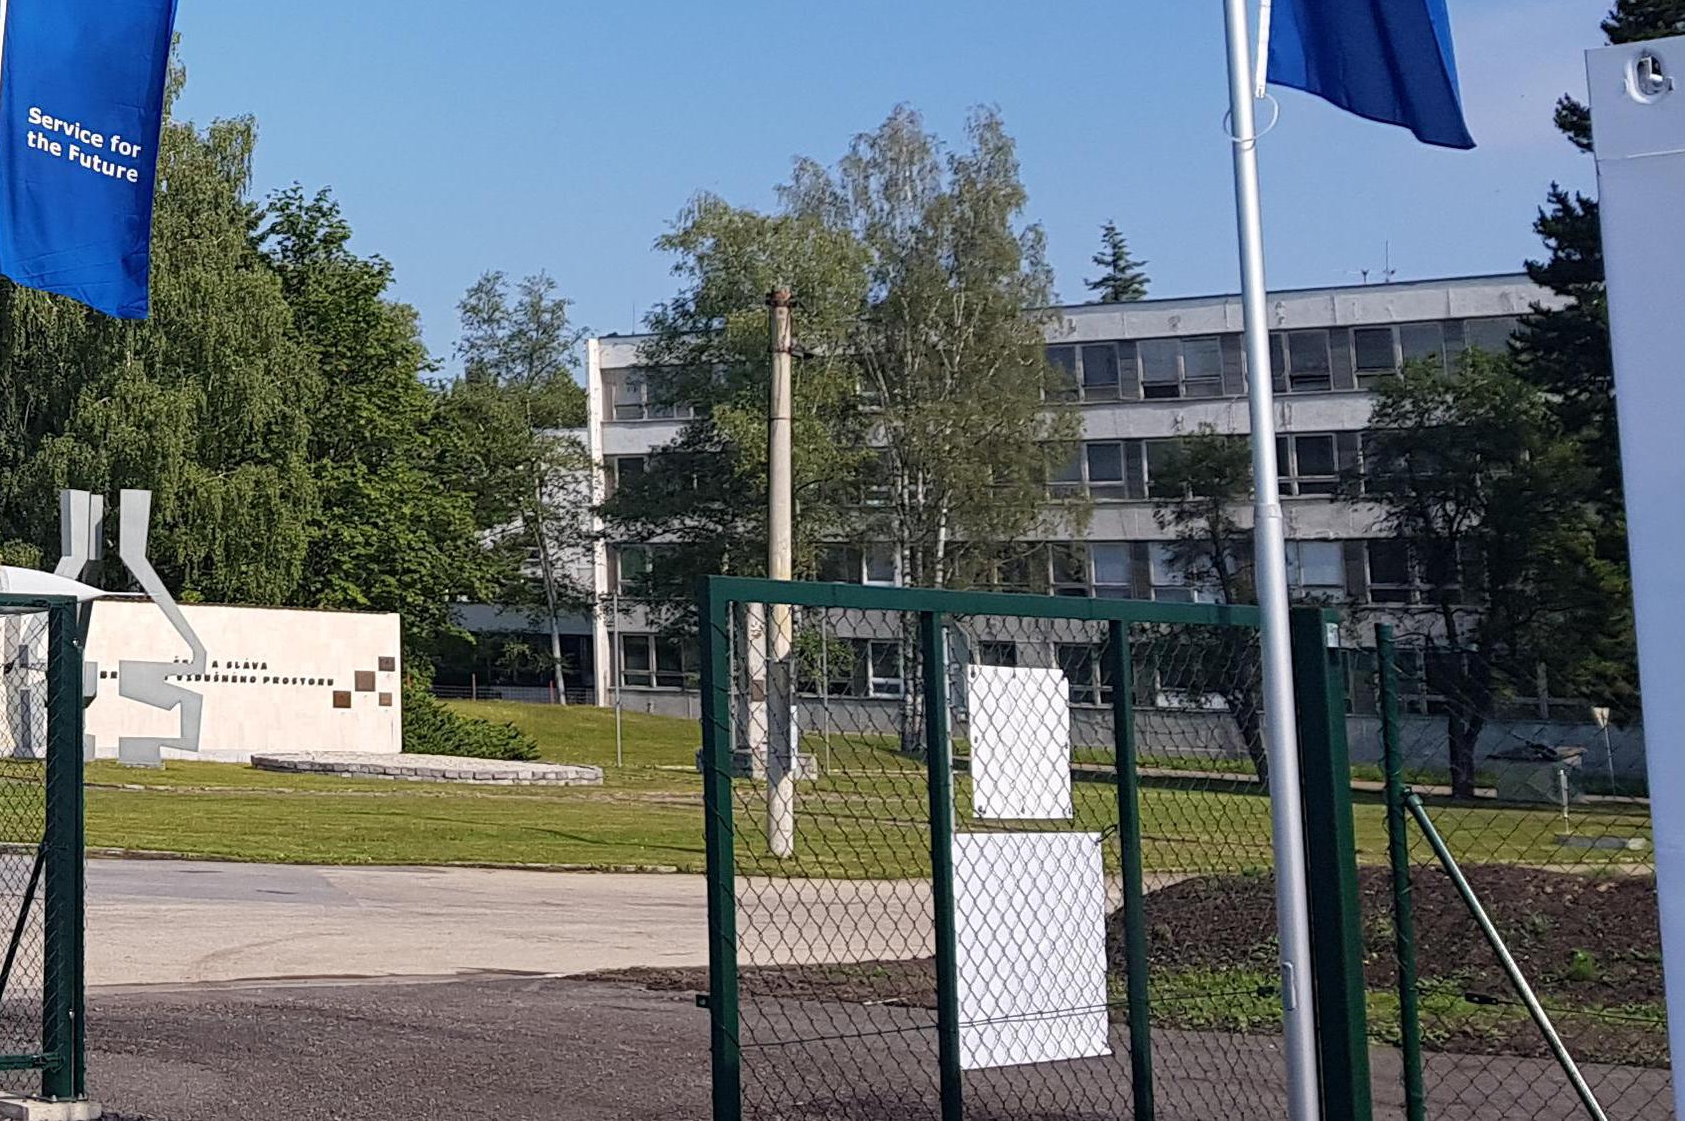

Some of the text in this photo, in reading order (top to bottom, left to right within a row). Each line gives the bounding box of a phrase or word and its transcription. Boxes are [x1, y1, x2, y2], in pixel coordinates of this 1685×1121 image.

[26, 130, 139, 183] the Future
[27, 107, 142, 159] Service for
